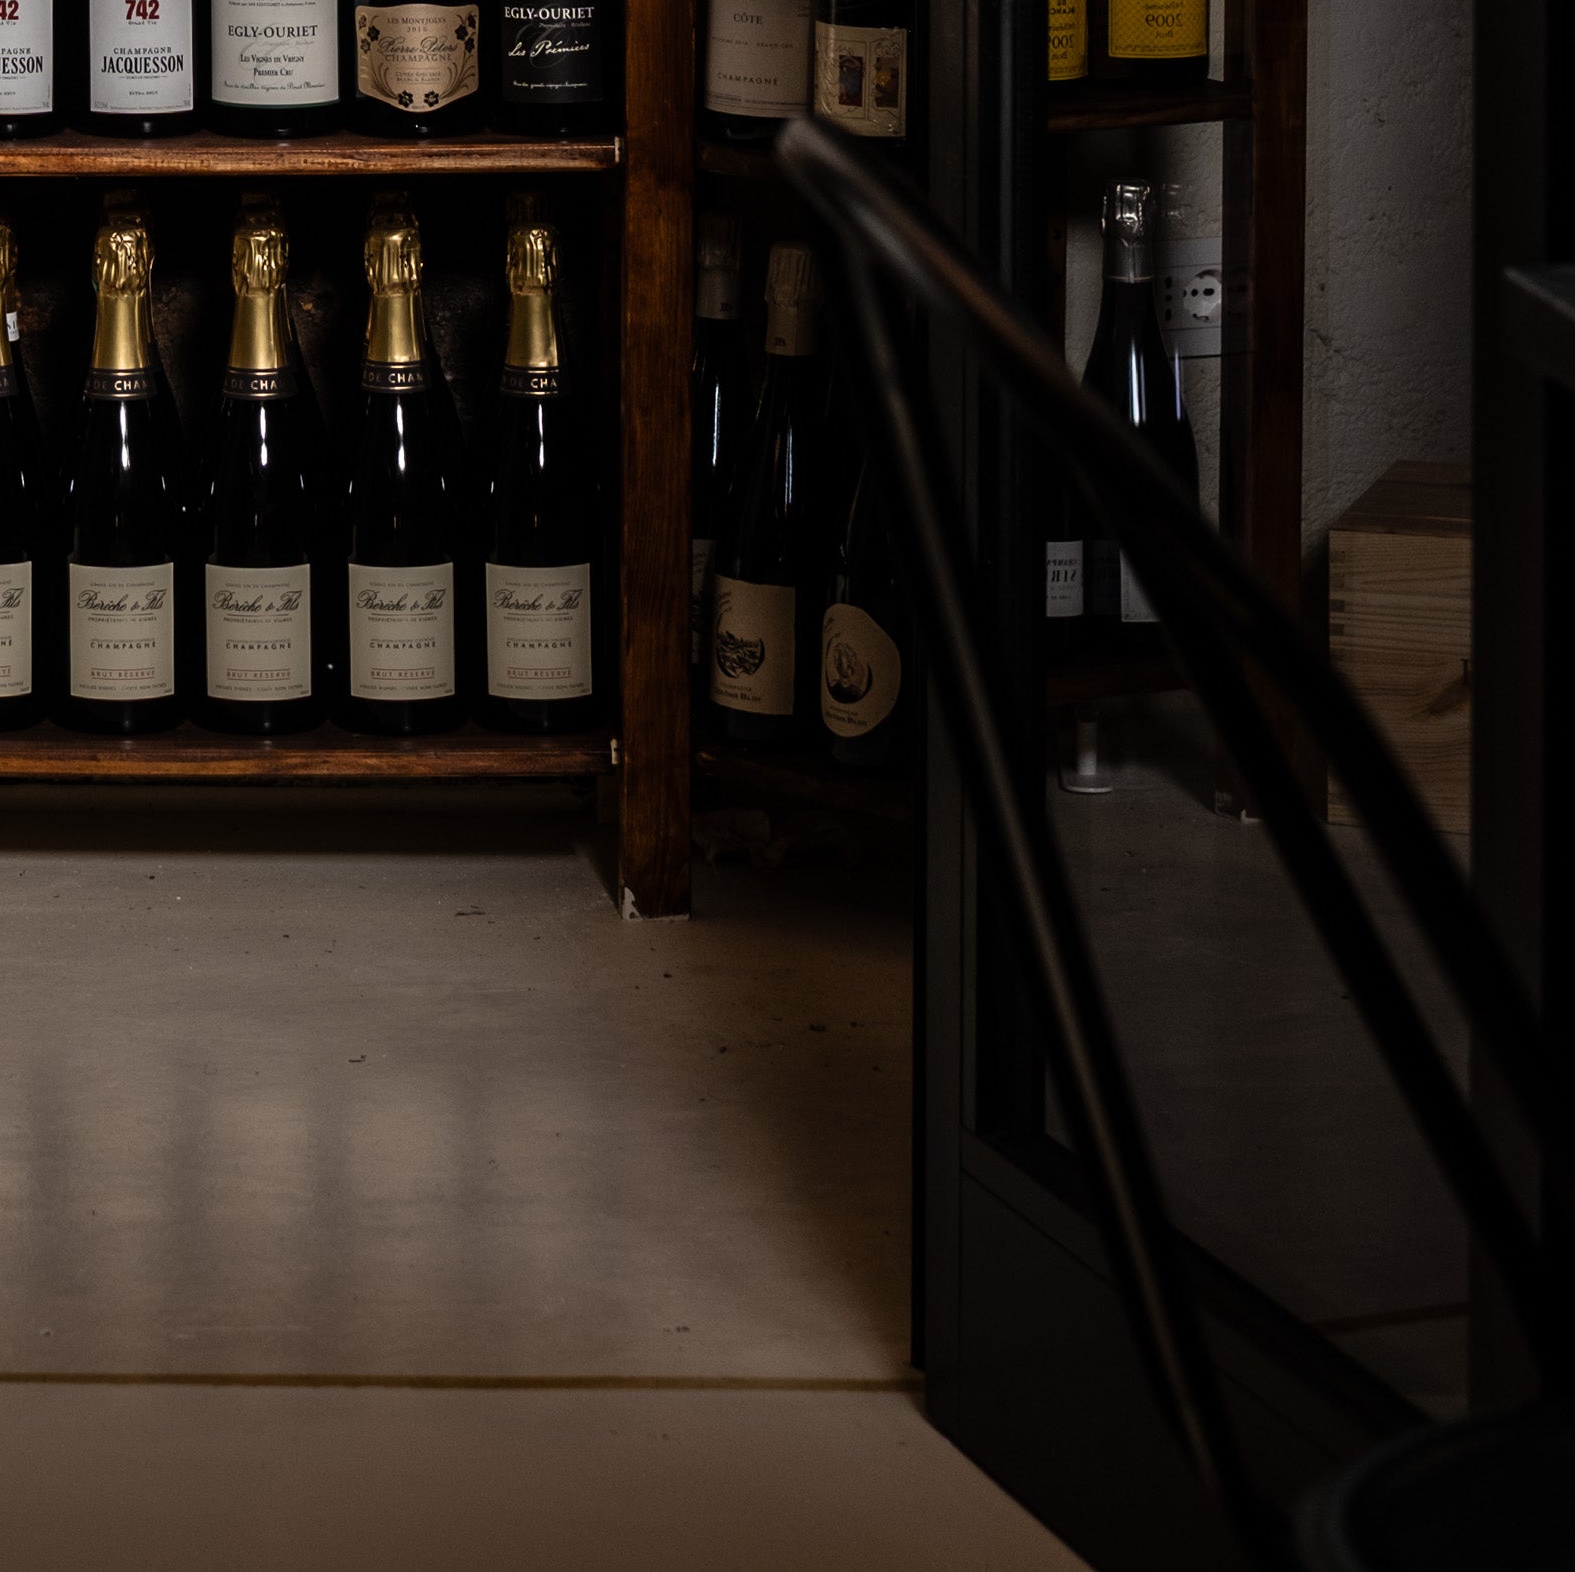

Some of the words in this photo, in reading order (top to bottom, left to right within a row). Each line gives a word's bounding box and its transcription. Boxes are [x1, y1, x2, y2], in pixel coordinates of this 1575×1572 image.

[125, 0, 160, 20] 742
[504, 6, 594, 19] EGLY-OURIET
[734, 13, 763, 24] CÔTE
[228, 25, 318, 38] EGLY-OURIET
[113, 47, 172, 55] CHAMPAGNE
[508, 41, 526, 56] Les
[101, 55, 184, 74] JACQUESSON
[384, 54, 452, 62] CHAMPAGNE
[718, 72, 778, 86] CHAMPAGNE
[141, 588, 167, 611] Fils
[276, 590, 302, 612] Fils
[422, 588, 446, 610] Fils
[557, 588, 583, 610] Fils
[369, 641, 436, 649] CHAMPAGNE
[506, 641, 573, 649] CHAMPAGNE
